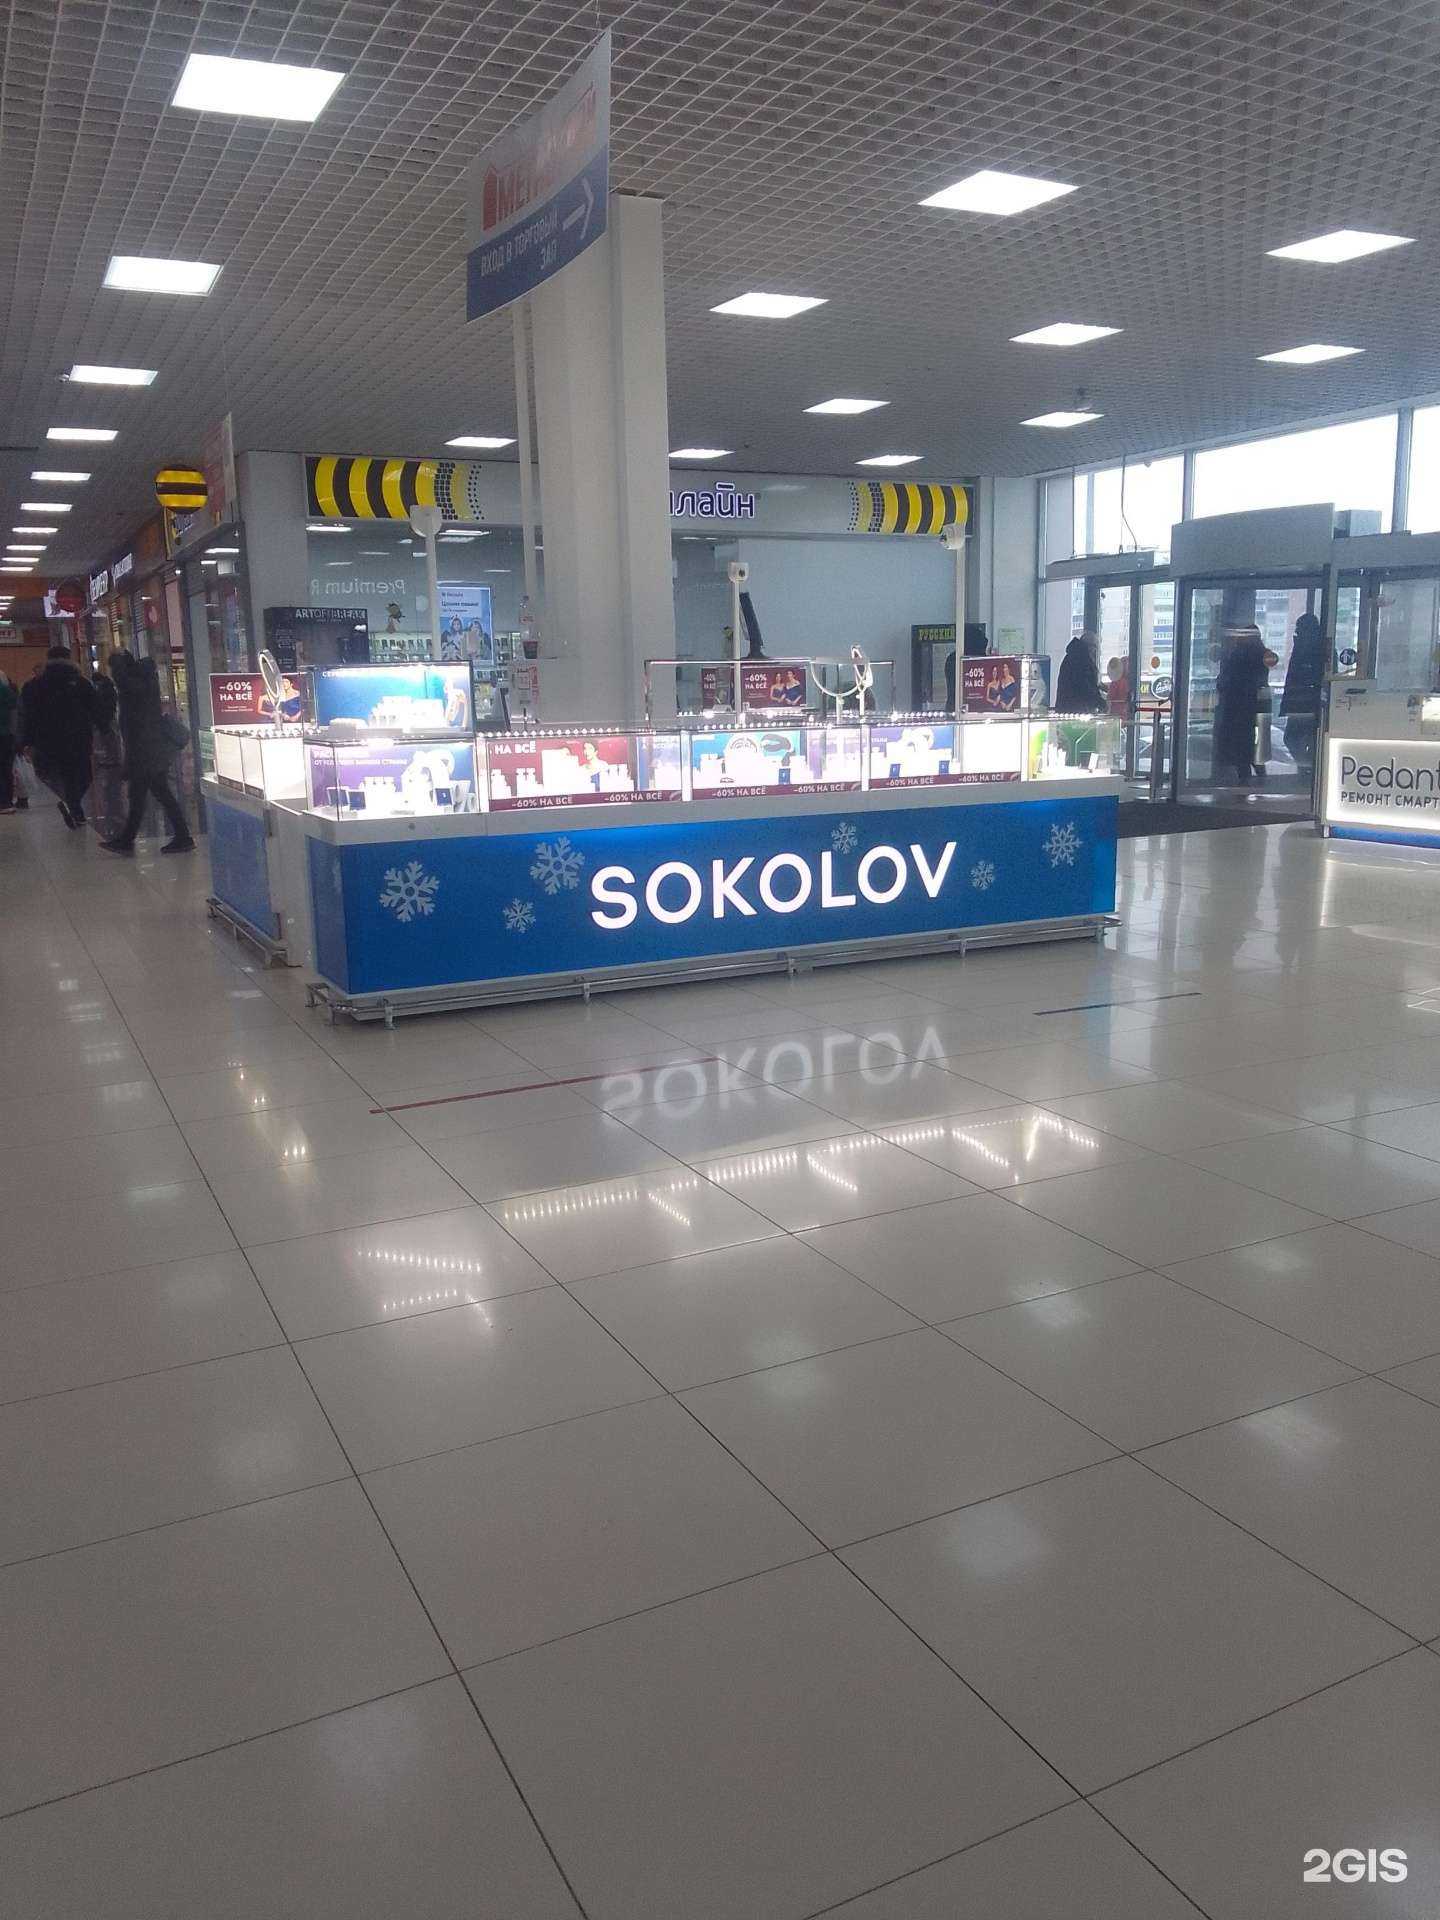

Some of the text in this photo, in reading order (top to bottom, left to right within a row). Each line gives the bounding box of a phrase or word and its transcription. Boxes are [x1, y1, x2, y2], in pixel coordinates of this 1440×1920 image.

[481, 252, 505, 277] ВХОД
[506, 242, 513, 262] В
[540, 239, 558, 271] ЗАЛ
[669, 482, 755, 518] лайн
[745, 673, 767, 682] -60%
[965, 667, 984, 678] -60%
[219, 681, 252, 691] -60%
[964, 680, 972, 688] НА
[220, 691, 253, 701] НА ВСЁ
[494, 741, 536, 754] НА ВСЁ
[886, 779, 906, 787] -60%
[908, 778, 919, 786] НА
[980, 774, 990, 782] НА
[712, 786, 766, 798] -60% НА ВСЁ
[794, 785, 815, 793] -60%
[817, 784, 828, 792] НА
[604, 791, 663, 802] -60% НА ВСЁ
[1341, 791, 1392, 806] РЕМОНТ
[512, 799, 537, 808] -60%
[540, 798, 554, 806] НА
[591, 841, 957, 930] SOKOLOV
